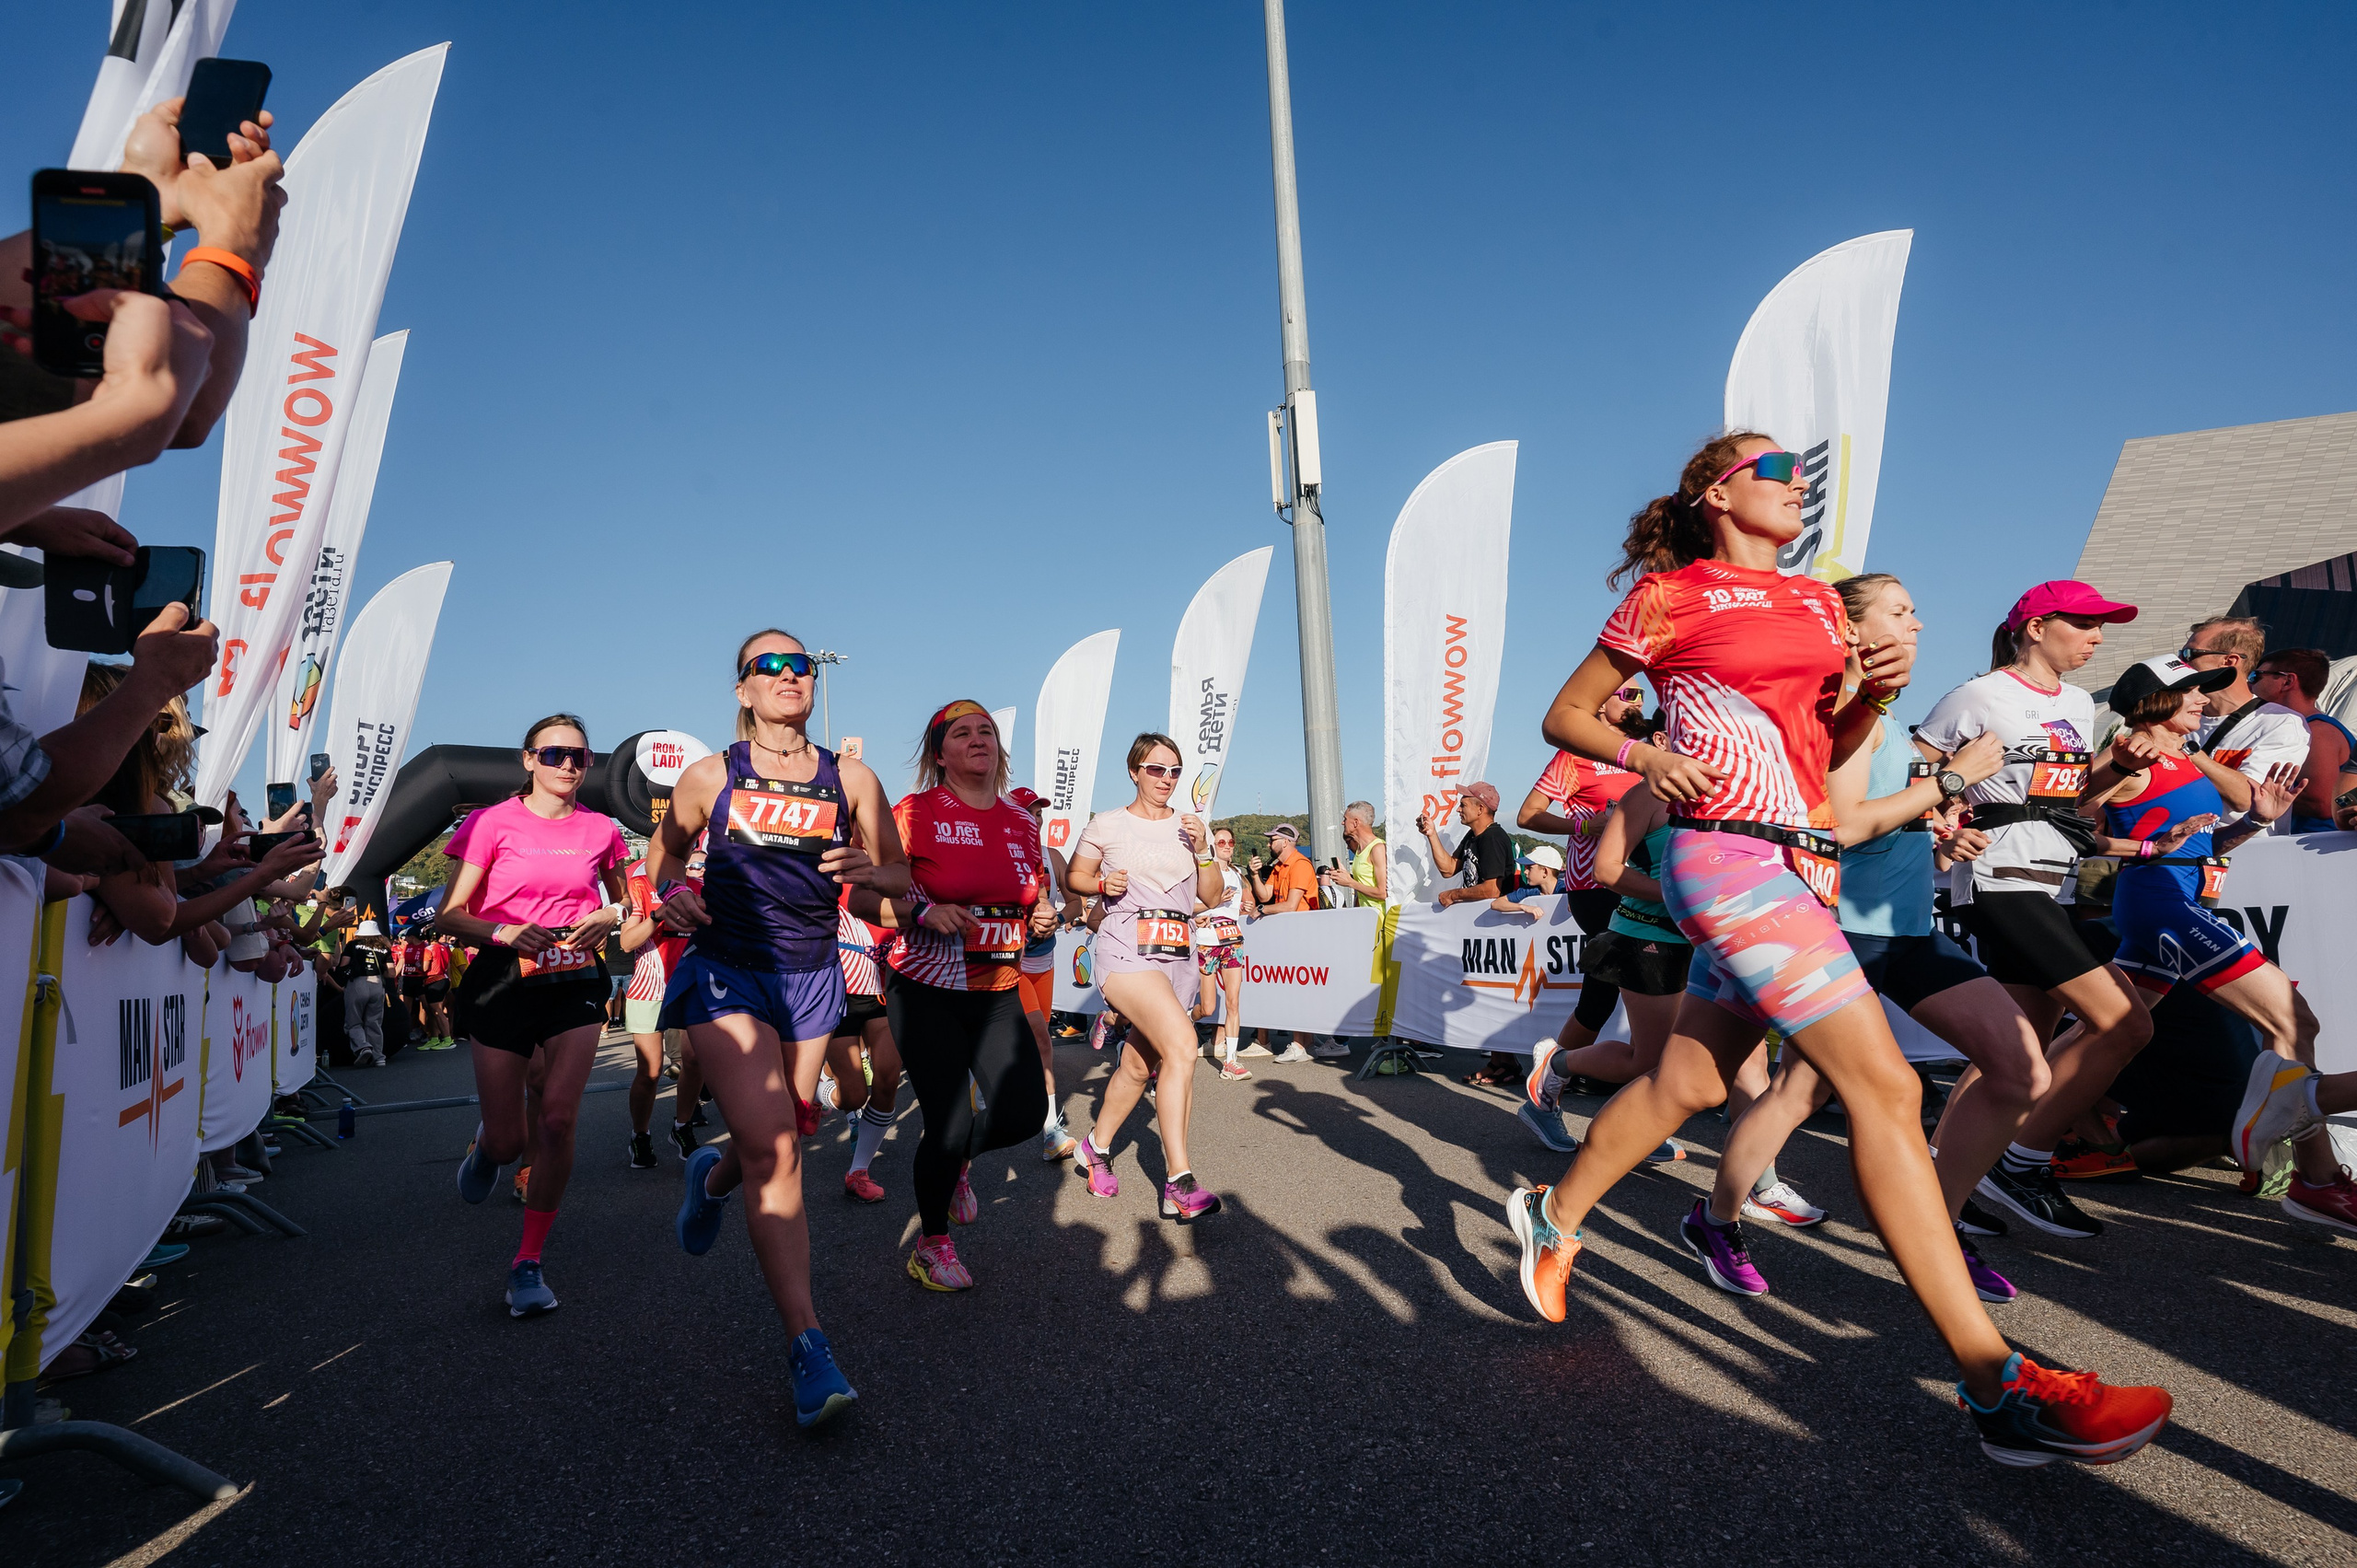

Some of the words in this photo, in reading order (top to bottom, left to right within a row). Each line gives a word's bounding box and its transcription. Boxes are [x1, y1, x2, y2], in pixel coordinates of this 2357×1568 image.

[1701, 588, 1732, 605] 10
[1431, 613, 1468, 779] flowwow
[653, 742, 675, 753] IRON
[652, 753, 684, 769] LADY
[1592, 761, 1607, 771] 10
[1053, 748, 1071, 811] СПОРТ
[1064, 748, 1080, 810] ЭКСПРЕСС
[749, 796, 819, 830] 7747
[934, 821, 952, 837] 10
[762, 833, 799, 846] НАТАЛЬЯ
[935, 834, 959, 844] SIRIUS
[961, 837, 983, 847] SOCHI
[1014, 862, 1032, 874] 20
[1018, 873, 1037, 887] 24
[1800, 856, 1836, 899] 7240
[979, 923, 1021, 945] 7704
[1148, 922, 1184, 942] 7152
[1461, 938, 1517, 974] MAN
[119, 998, 151, 1090] MAN
[163, 993, 185, 1073] STAR
